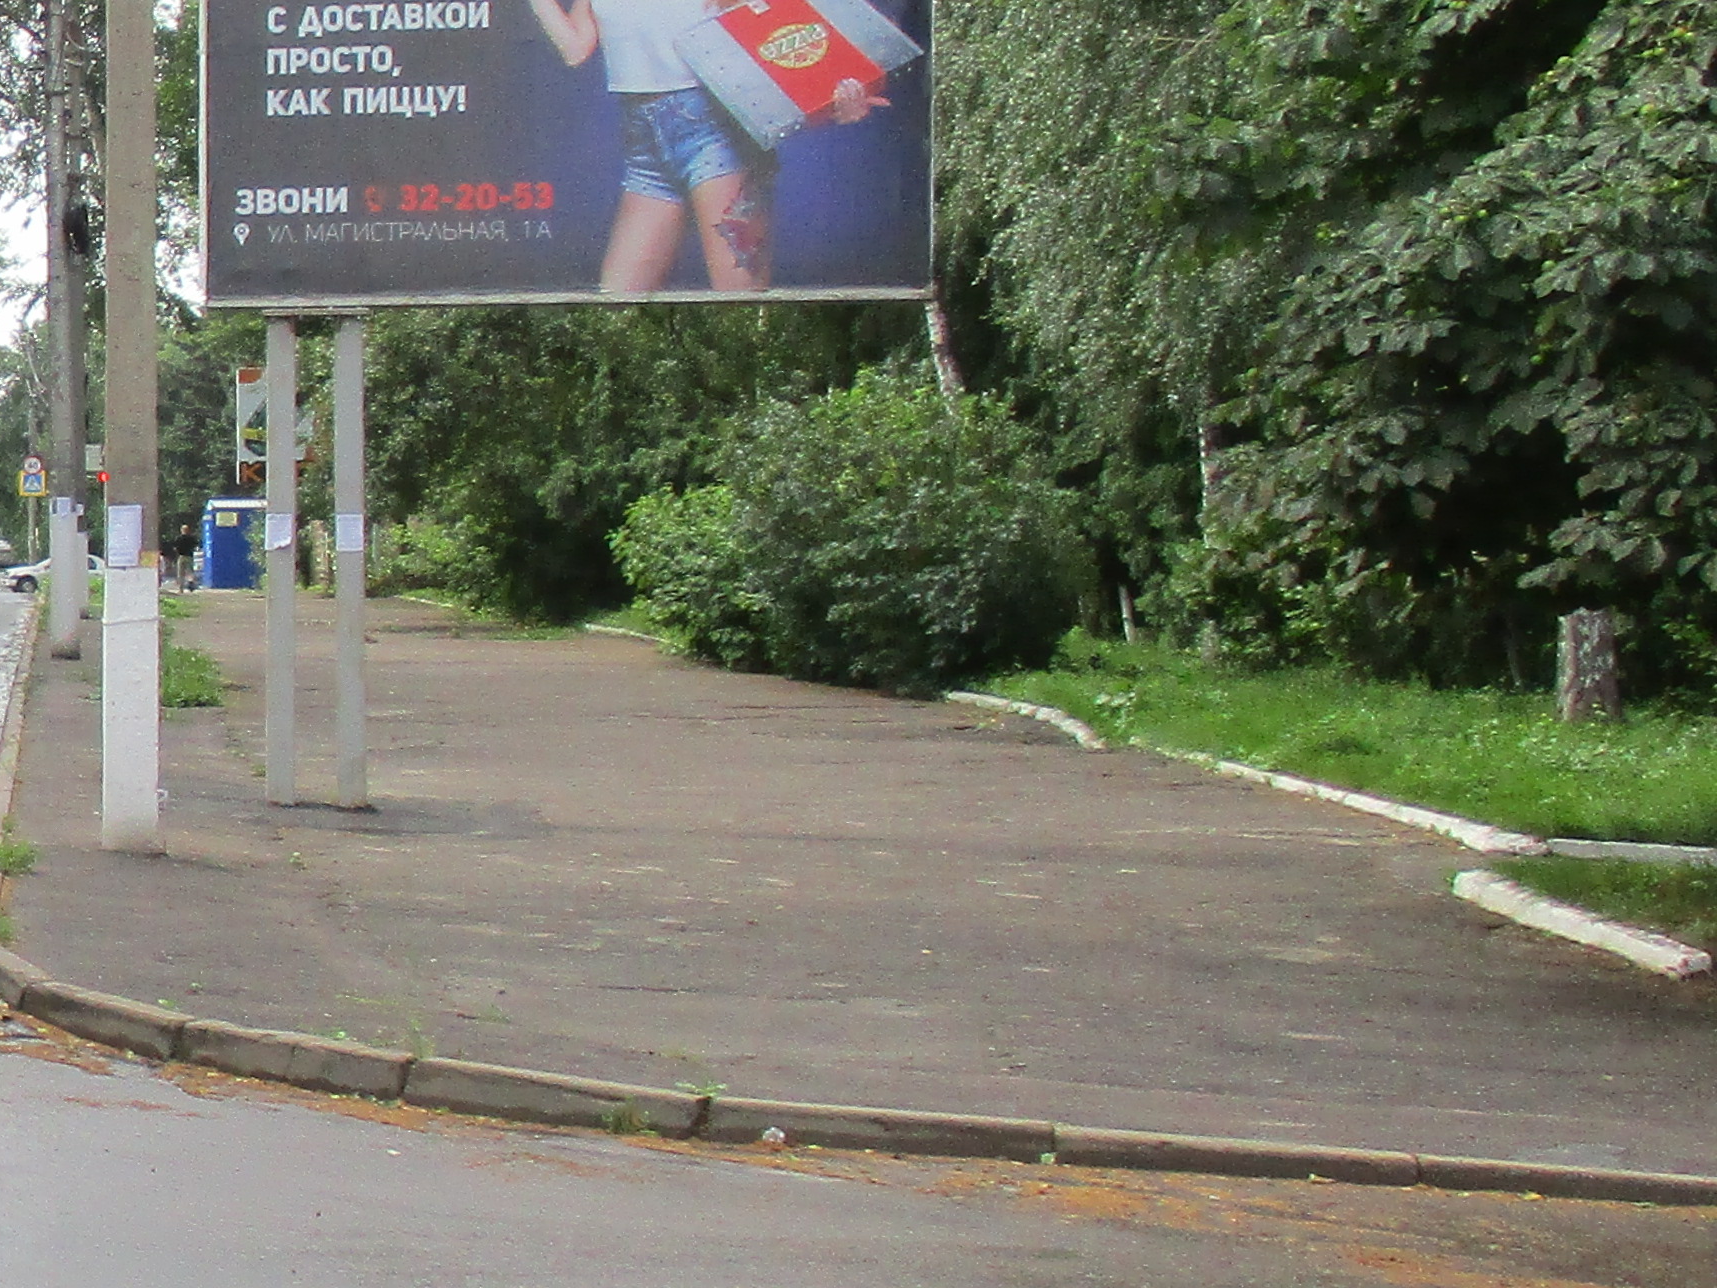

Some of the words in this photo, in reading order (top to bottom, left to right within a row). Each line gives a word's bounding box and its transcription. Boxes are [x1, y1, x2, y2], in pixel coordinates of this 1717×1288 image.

[267, 6, 287, 34] С
[267, 44, 402, 77] ПРОСТО,
[266, 88, 332, 117] КАК
[342, 84, 467, 119] ПИЦЦУ!
[234, 186, 349, 215] ЗВОНИ
[399, 181, 554, 212] 32-20-53
[267, 223, 298, 244] УЛ.
